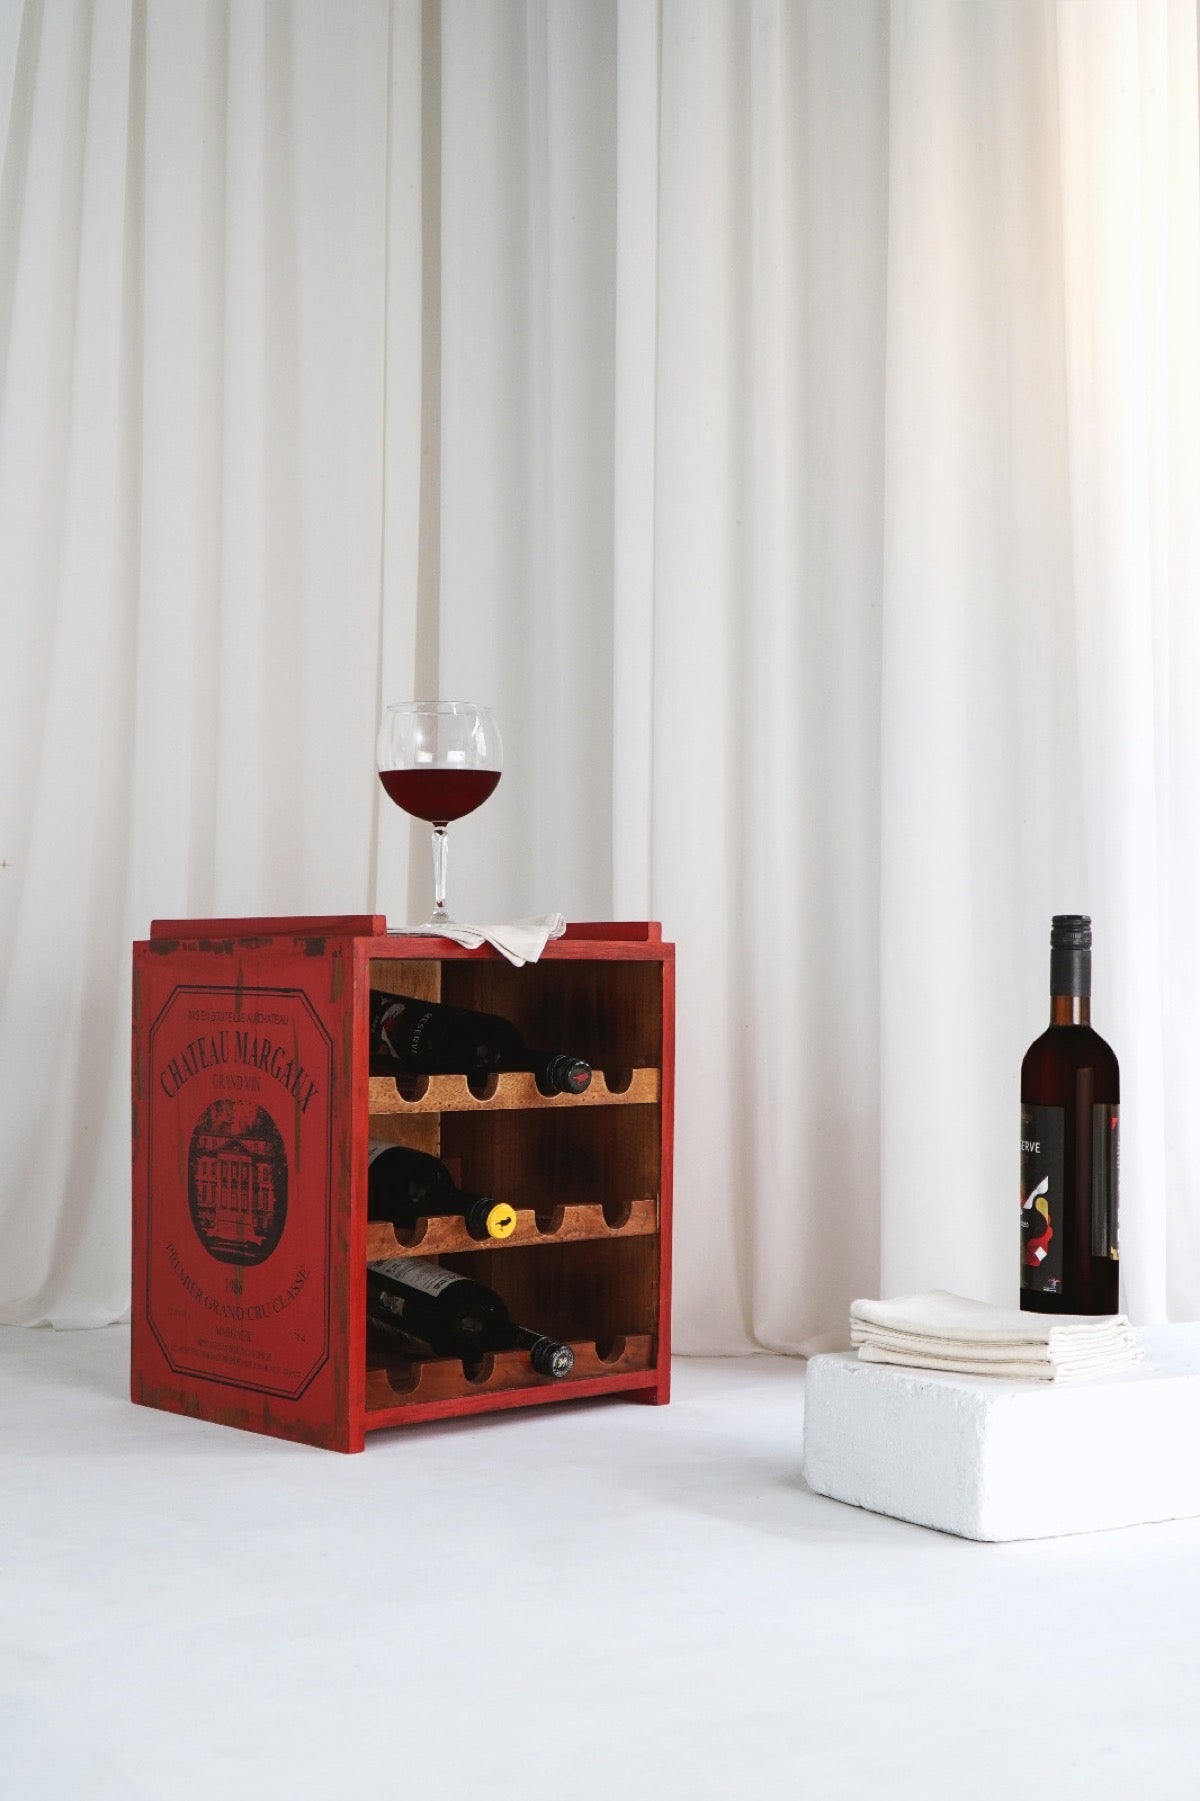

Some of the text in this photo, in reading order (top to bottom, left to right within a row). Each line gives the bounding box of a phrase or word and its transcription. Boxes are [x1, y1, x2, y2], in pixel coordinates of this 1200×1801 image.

[160, 1030, 319, 1114] CHATEAU MARGAUX
[204, 1295, 244, 1320] GRAND
[247, 1304, 271, 1321] CRU
